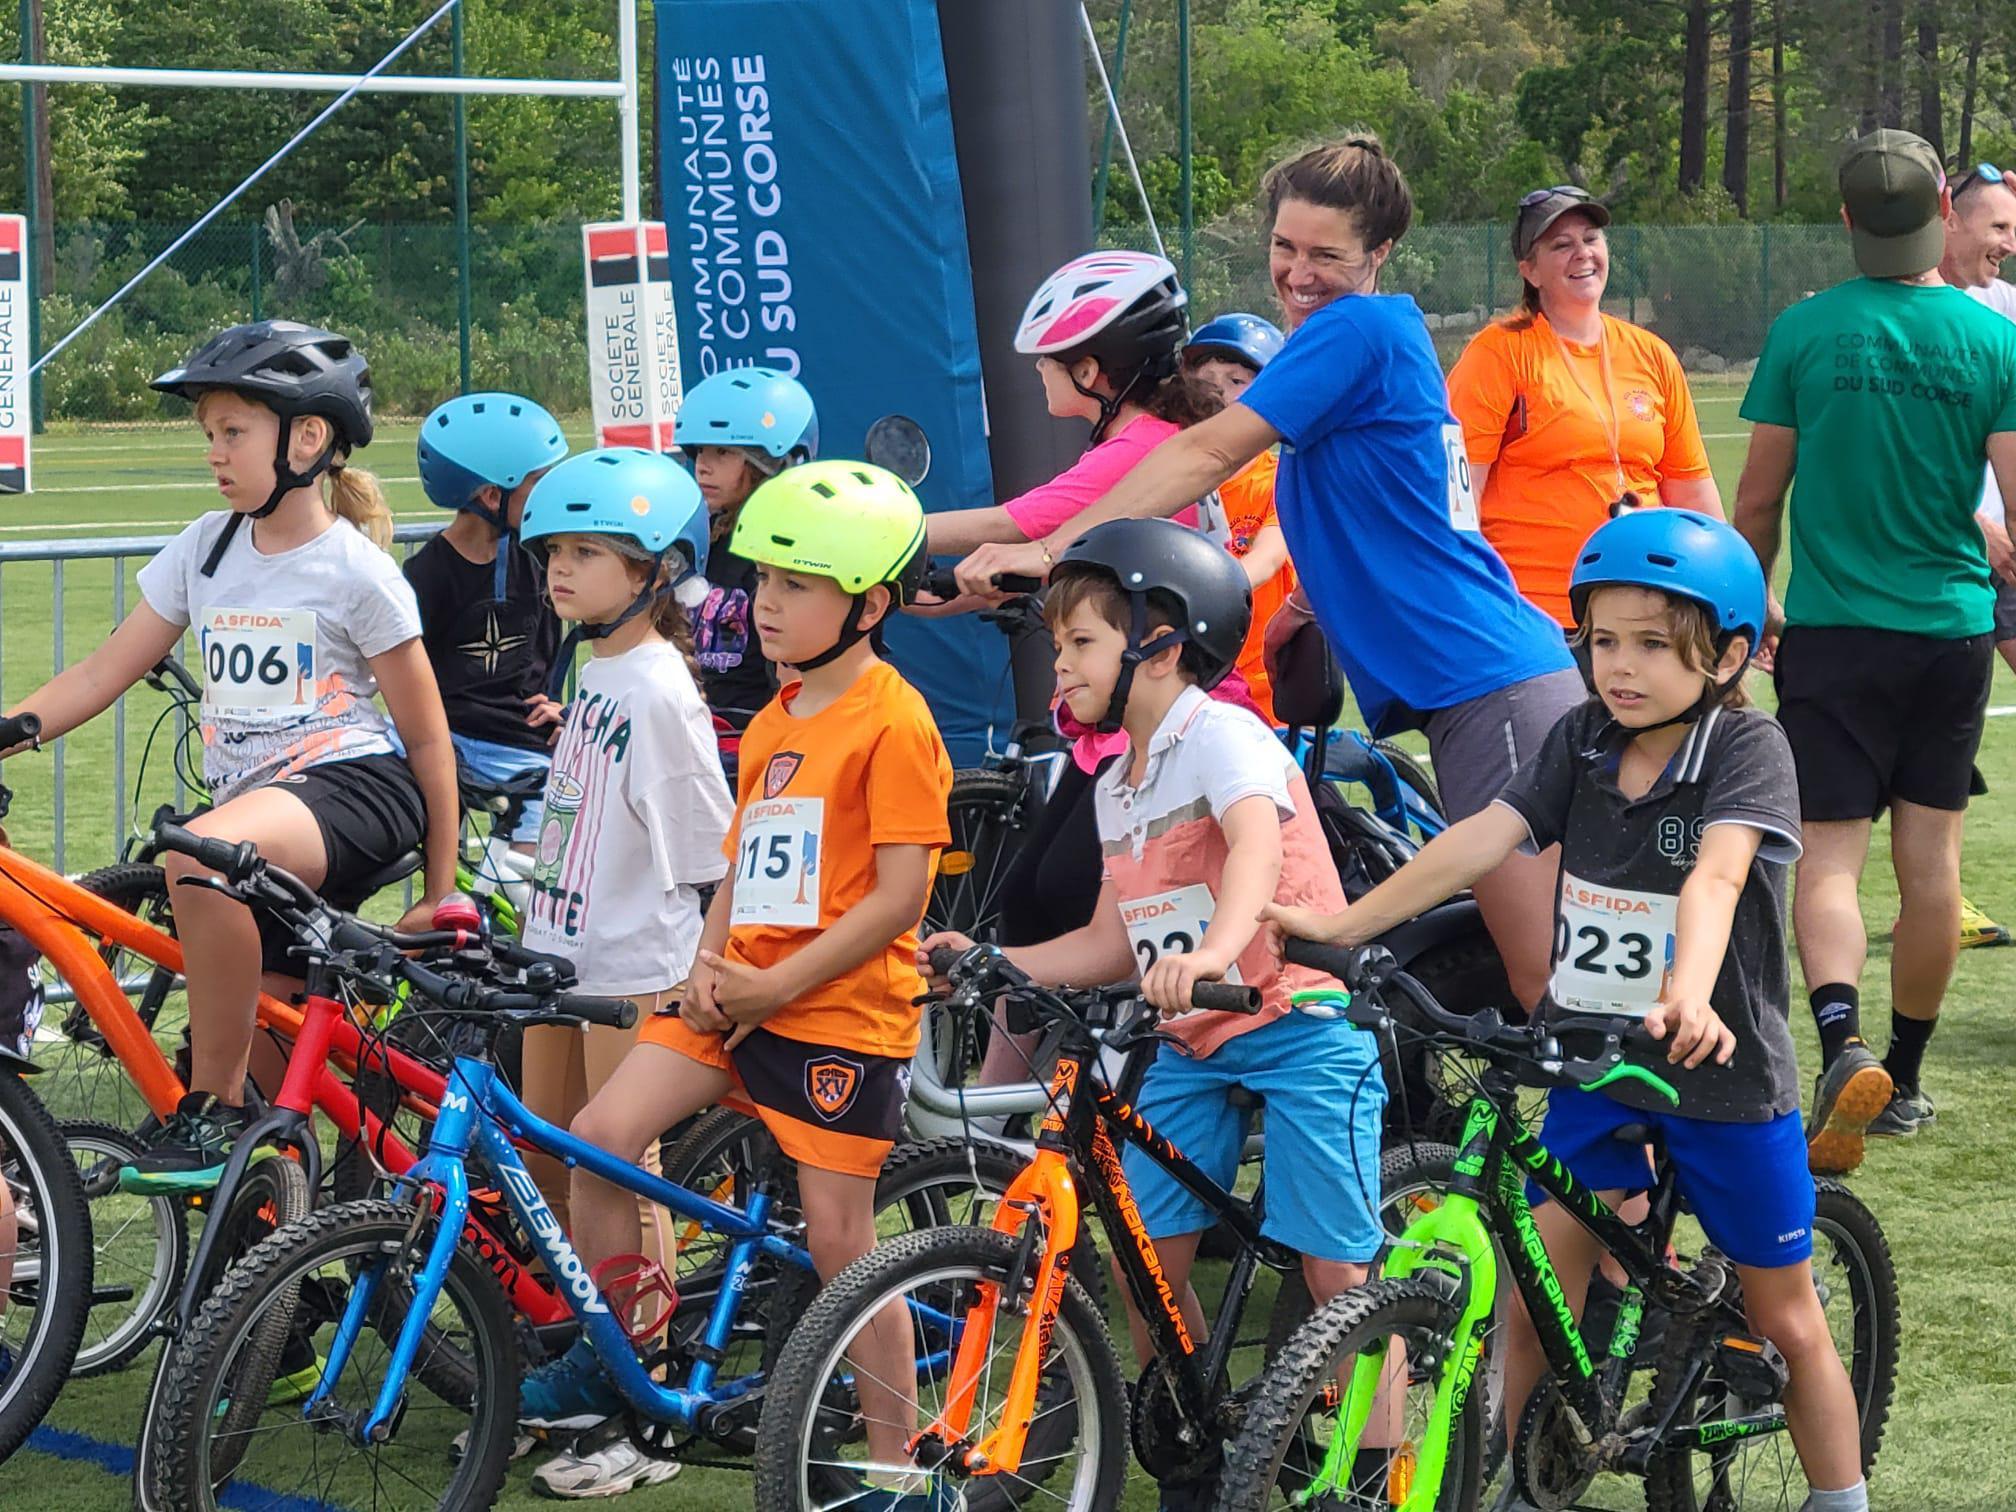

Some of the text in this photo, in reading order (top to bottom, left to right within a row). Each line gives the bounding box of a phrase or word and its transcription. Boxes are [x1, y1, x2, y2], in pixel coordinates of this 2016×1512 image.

[672, 57, 718, 378] OMMUNAUTÉ
[695, 57, 750, 340] COMMUNES
[731, 54, 801, 379] U SUD CORSE
[605, 314, 626, 419] SOCIETE
[620, 289, 644, 418] GENERALE
[655, 311, 672, 415] SOCIETE
[1835, 353, 1860, 369] DE
[1834, 376, 1974, 408] DU SUD CORSE
[214, 614, 284, 628] A SFIDA
[209, 641, 289, 686] 006
[736, 834, 793, 884] 15
[1124, 900, 1177, 923] SFIDA
[1565, 882, 1575, 899] A
[1577, 890, 1652, 914] SFIDA
